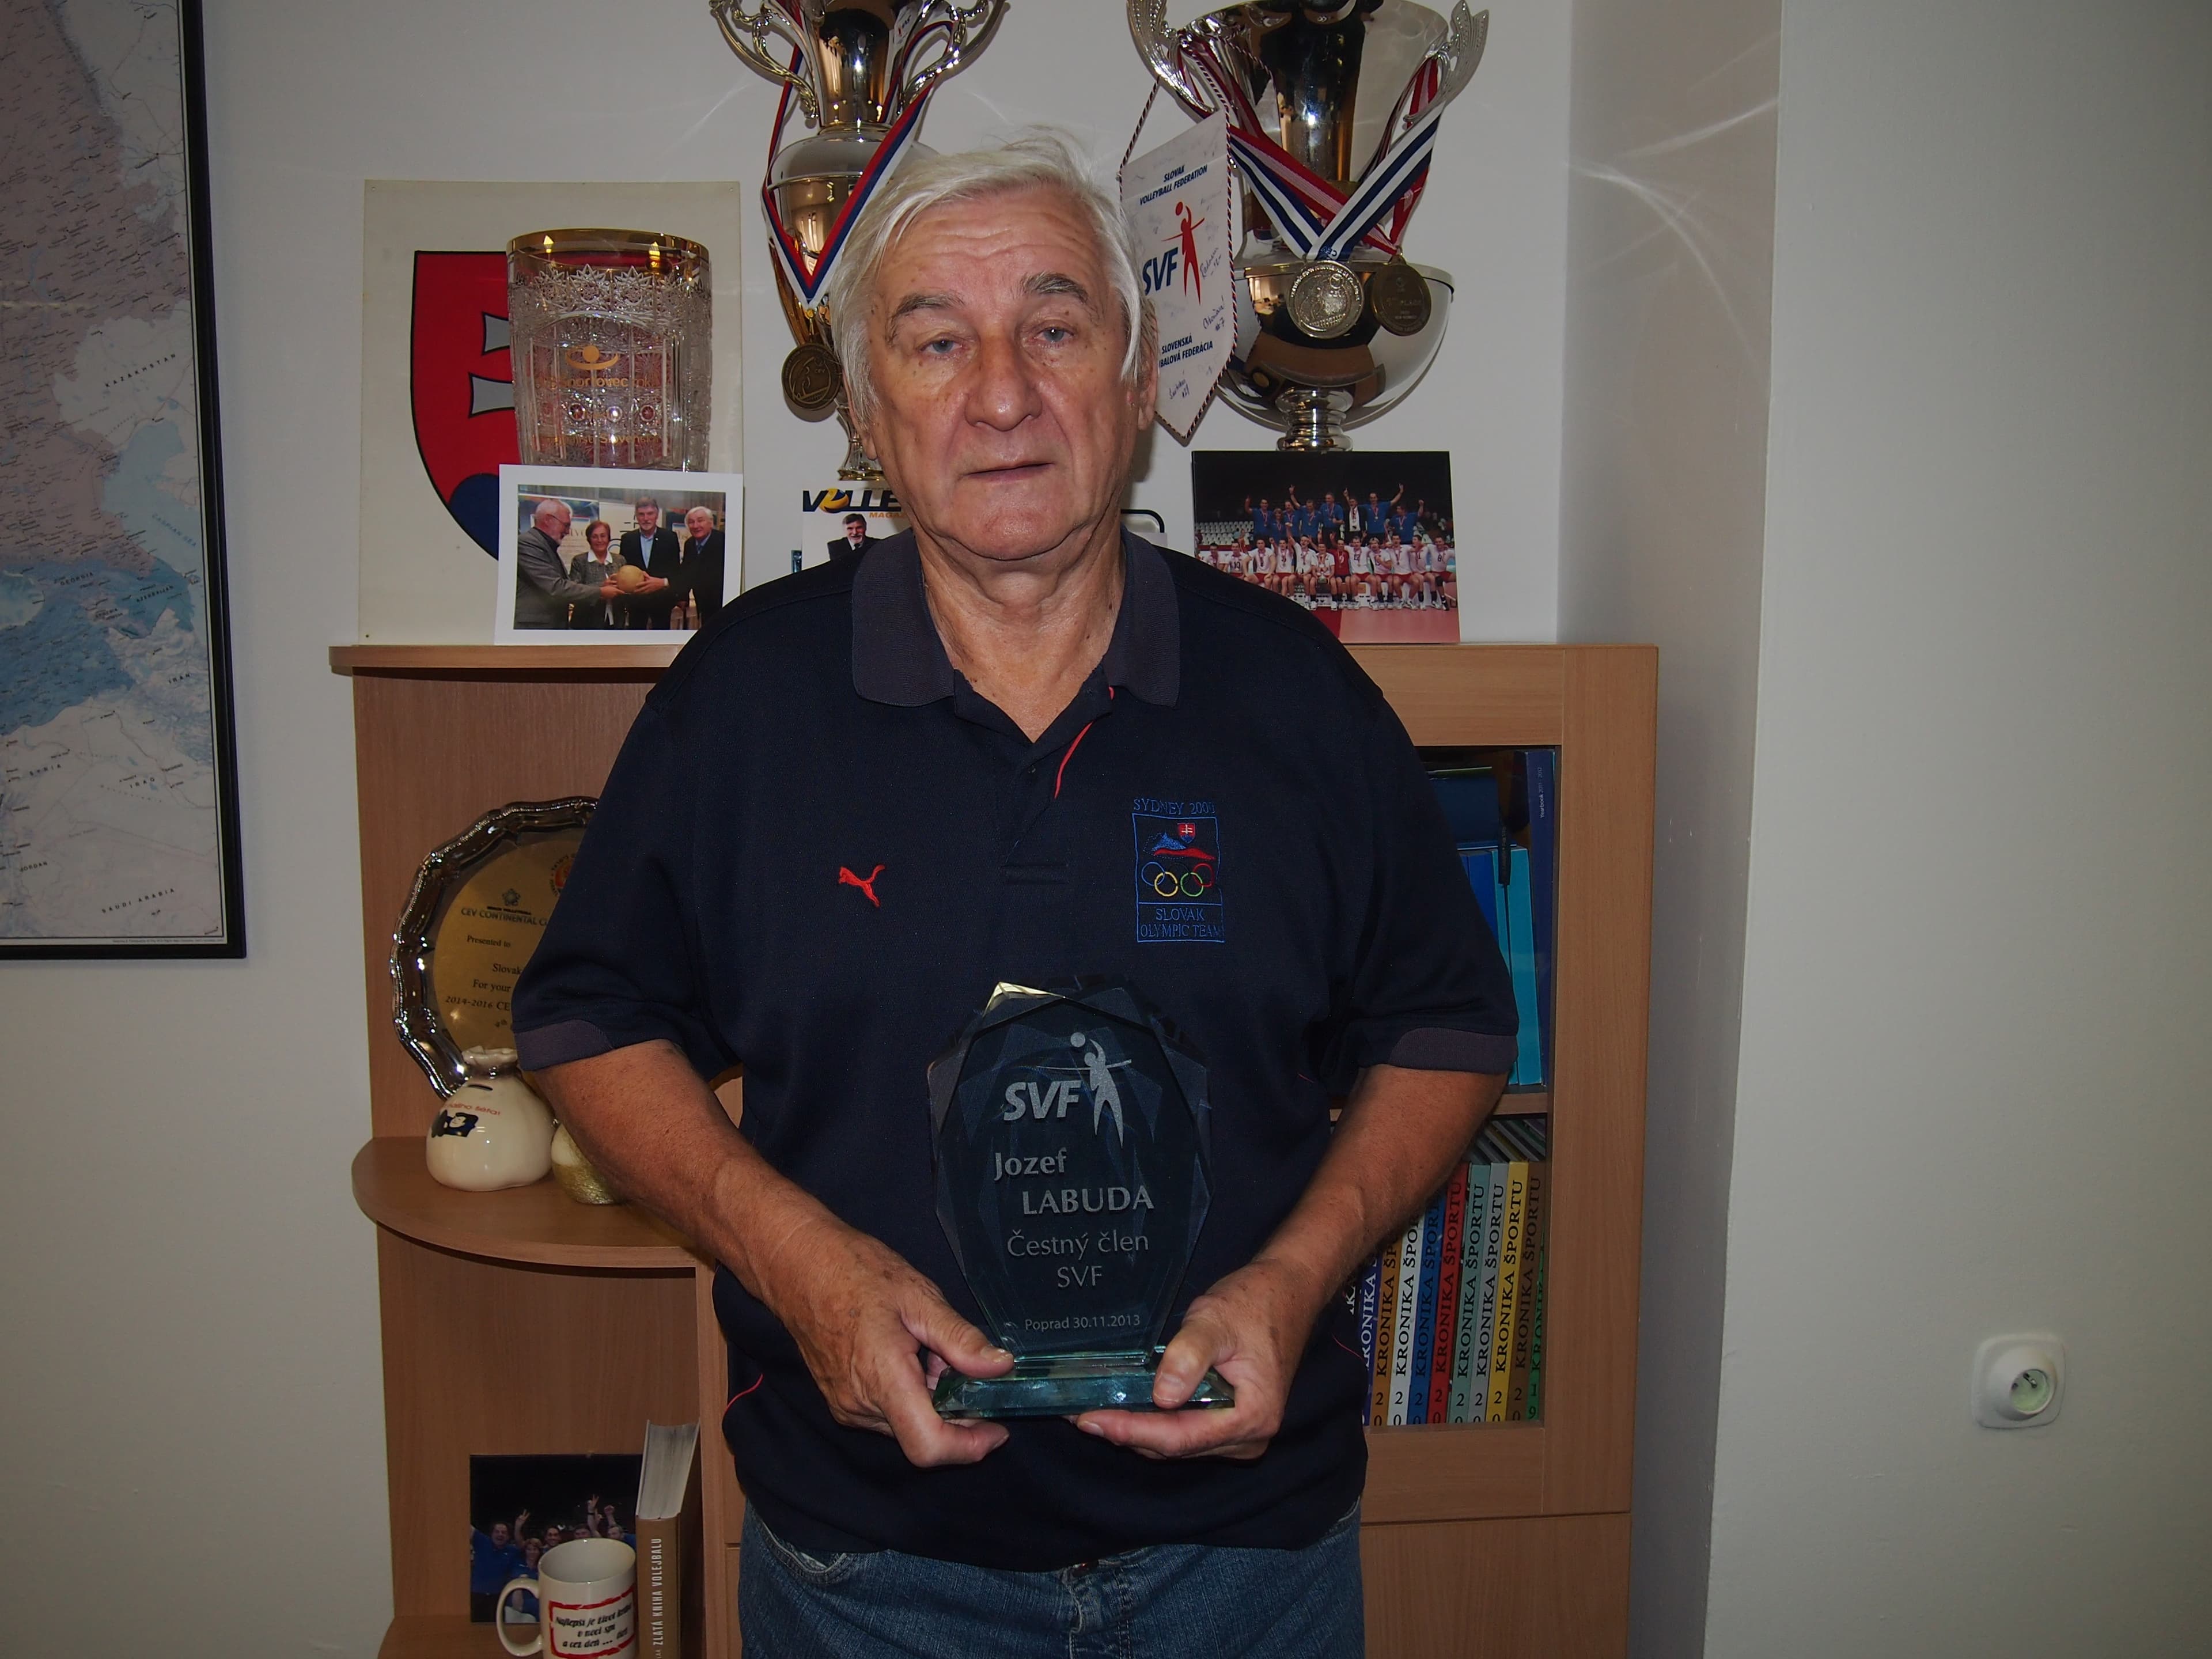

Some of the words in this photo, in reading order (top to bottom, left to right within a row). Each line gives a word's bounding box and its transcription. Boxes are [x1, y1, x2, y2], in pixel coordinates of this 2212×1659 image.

[1139, 184, 1173, 206] VOLLEYBALL
[1173, 164, 1208, 190] FEDERATION
[1164, 164, 1185, 182] SLOVAK
[1142, 247, 1179, 296] SVF
[1161, 333, 1193, 355] SLOVENSKÁ
[1182, 341, 1214, 361] FEDERÁCIA
[168, 672, 191, 685] IRAN
[29, 764, 62, 776] SYRIA
[130, 777, 156, 789] IRAQ
[1133, 797, 1185, 815] SYDNEY
[20, 861, 48, 872] JORDAN
[101, 900, 132, 914] SAUDI
[138, 888, 176, 903] ARABIA
[461, 907, 477, 917] CEV
[479, 909, 537, 925] CONTINENTAL
[1156, 907, 1205, 921] SLOVAK
[467, 935, 502, 947] Presented
[1141, 923, 1190, 938] OLYMPIC
[472, 979, 488, 990] For
[490, 983, 512, 993] your
[445, 996, 494, 1009] 2014-2016
[1003, 1080, 1082, 1122] SVF
[994, 1147, 1067, 1181] Jozef
[1022, 1184, 1156, 1215] LABUDA
[1443, 1181, 1462, 1266] ŠPORTU
[1465, 1184, 1484, 1269] ŠPORTU
[1484, 1183, 1504, 1268] ŠPORTU
[1503, 1179, 1523, 1265] ŠPORTU
[1522, 1177, 1541, 1262] ŠPORTU
[1006, 1229, 1089, 1261] Čestný
[1097, 1229, 1150, 1253] člen
[1057, 1266, 1103, 1288] SVF
[1025, 1316, 1070, 1332] Poprad
[1073, 1315, 1141, 1328] 30.11.2013
[1360, 1274, 1377, 1370] RONIKA
[1377, 1275, 1395, 1377] KRONIKA
[1396, 1274, 1415, 1376] KRONIKA
[1415, 1275, 1434, 1377] KRONIKA
[1436, 1272, 1455, 1373] KRONIKA
[1457, 1275, 1477, 1377] KRONIKA
[1476, 1274, 1497, 1377] KRONIKA
[1495, 1271, 1515, 1373] KRONIKA
[1516, 1268, 1533, 1369] KRONIKA
[650, 1538, 663, 1587] VOLEJBALU
[652, 1590, 663, 1616] KNIHA
[653, 1620, 664, 1646] ZLATÁ
